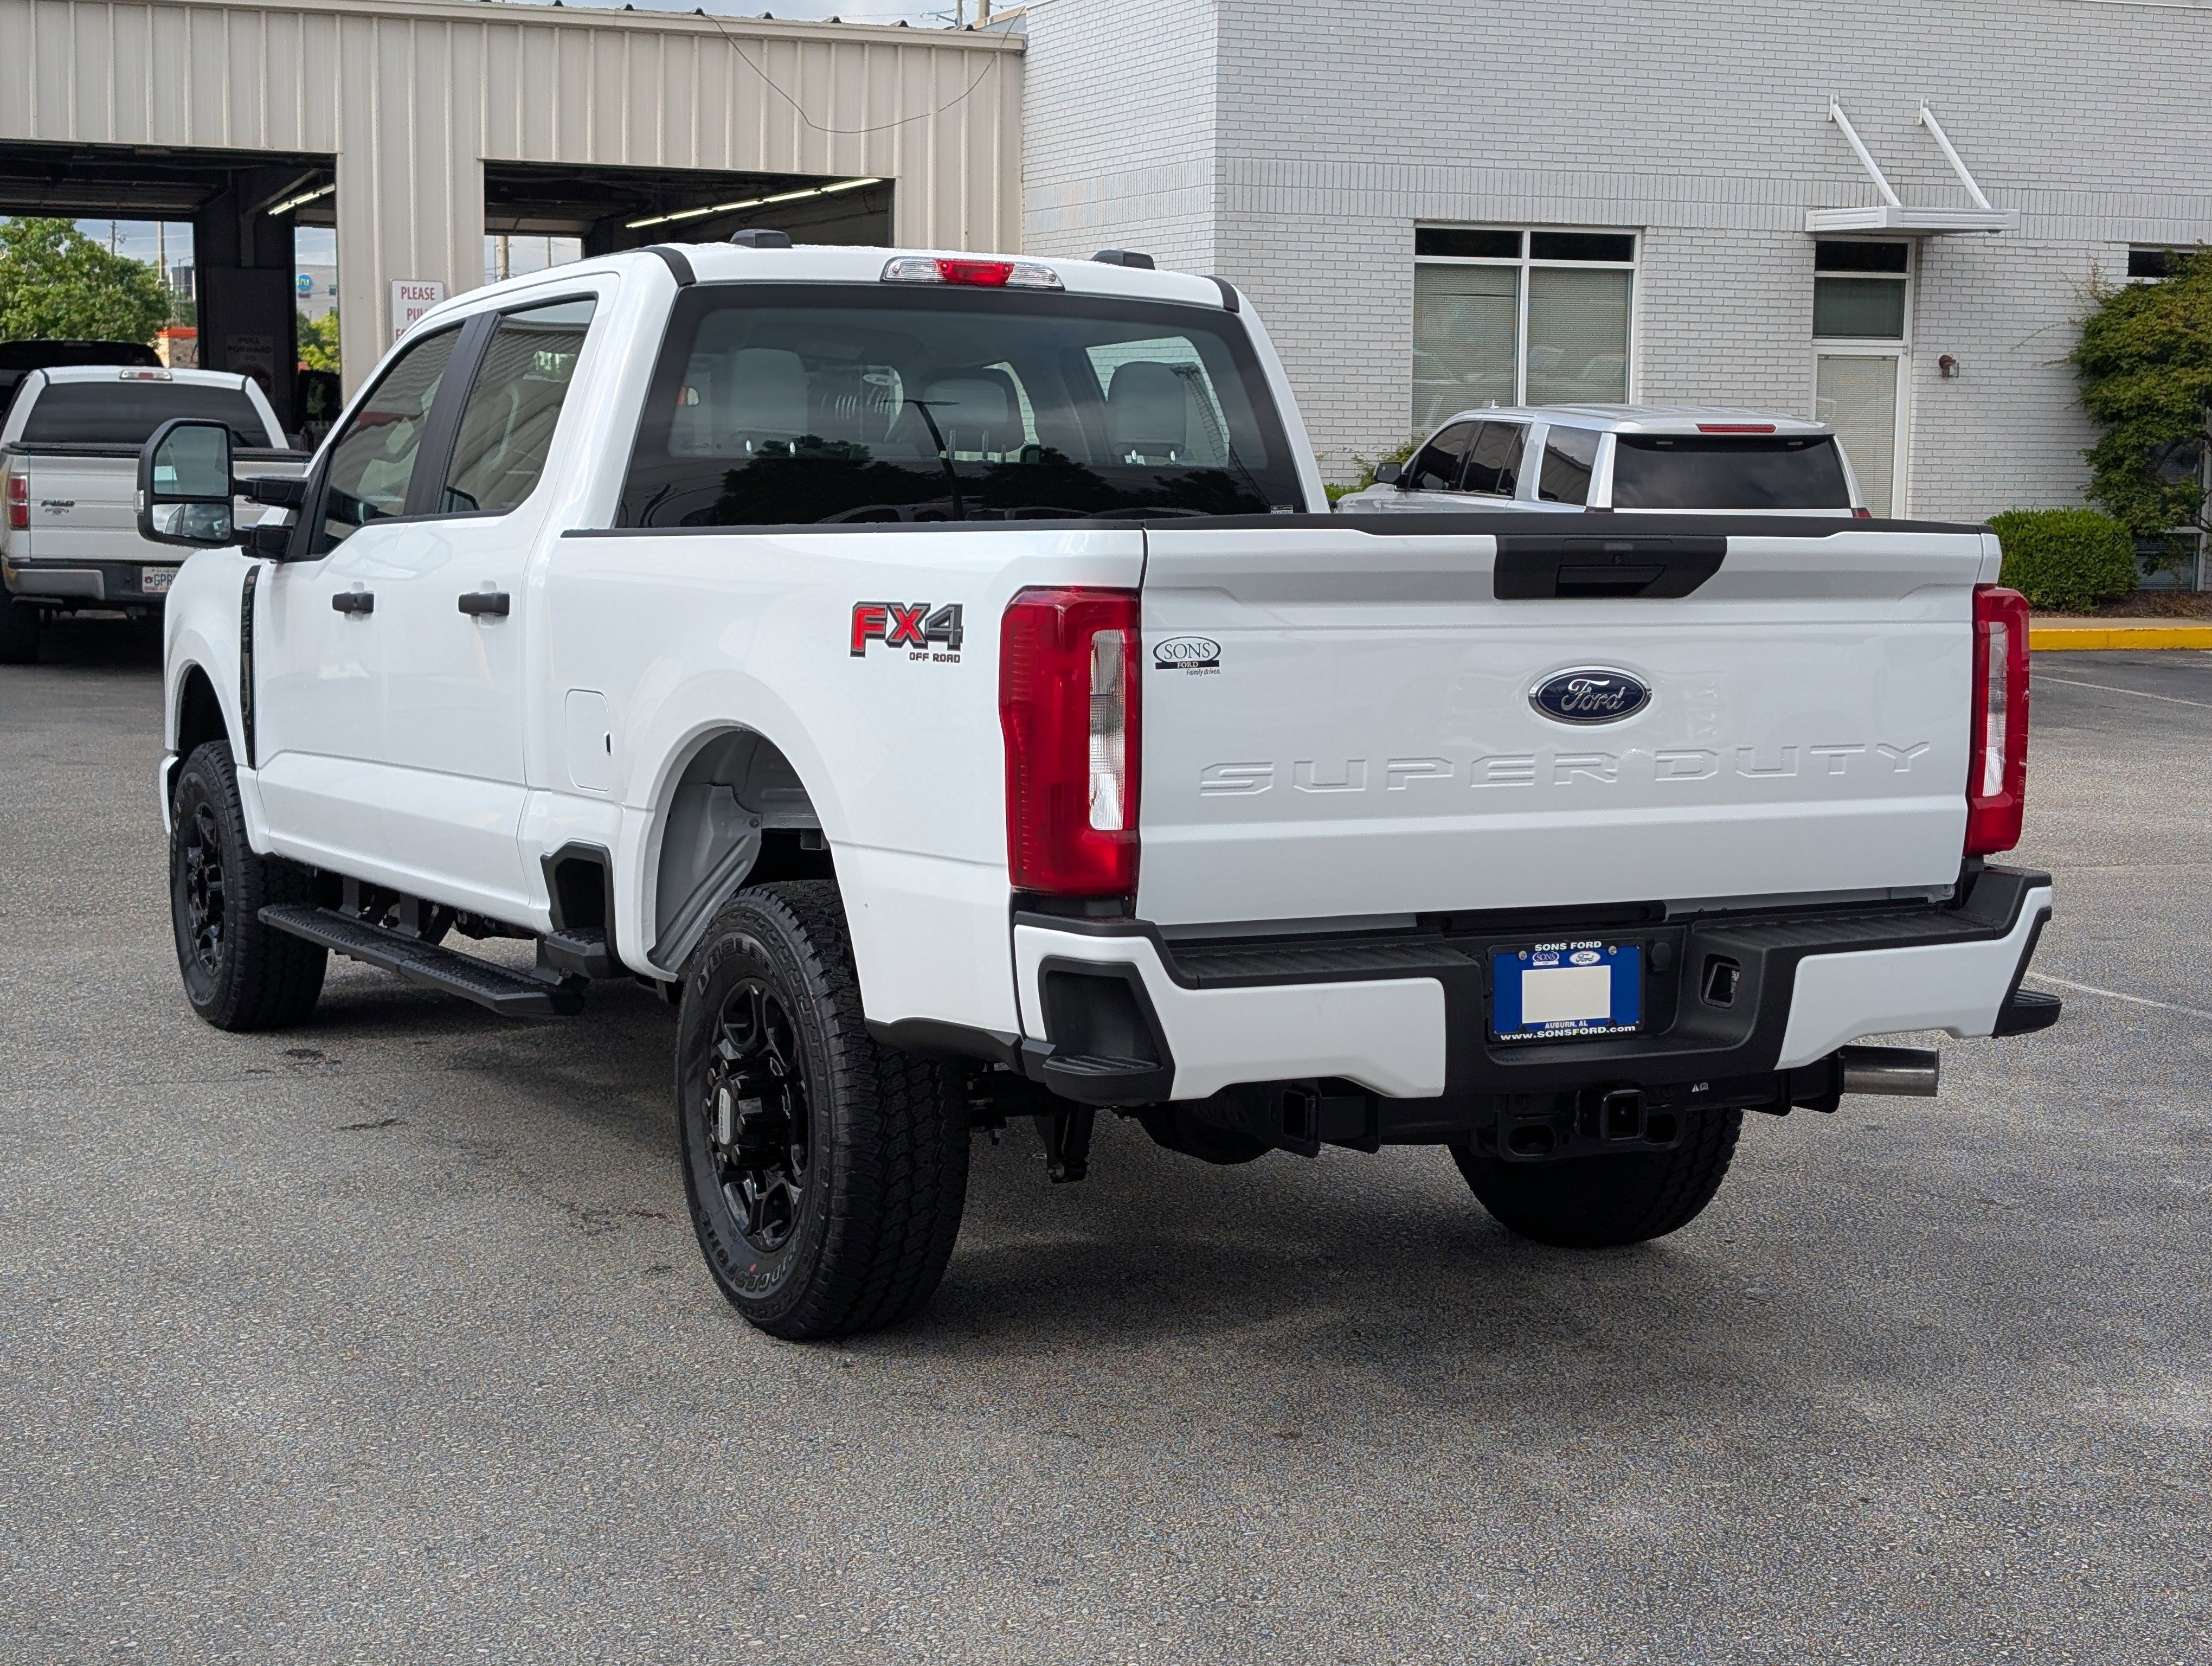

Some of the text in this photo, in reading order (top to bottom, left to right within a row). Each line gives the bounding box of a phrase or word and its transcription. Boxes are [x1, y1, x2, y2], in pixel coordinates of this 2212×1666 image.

[401, 286, 435, 300] PLEASE
[407, 308, 427, 321] PU
[850, 601, 963, 657] FX4
[909, 652, 960, 663] OFF ROAD
[1164, 643, 1210, 659] SONS
[1561, 678, 1626, 711] Ford
[1200, 741, 1930, 796] SUPER DUTY
[1535, 941, 1602, 951] SONS FORD
[1536, 953, 1555, 961] SONS
[1576, 953, 1594, 963] Ford
[1501, 1026, 1636, 1040] www.SONSFORD.com
